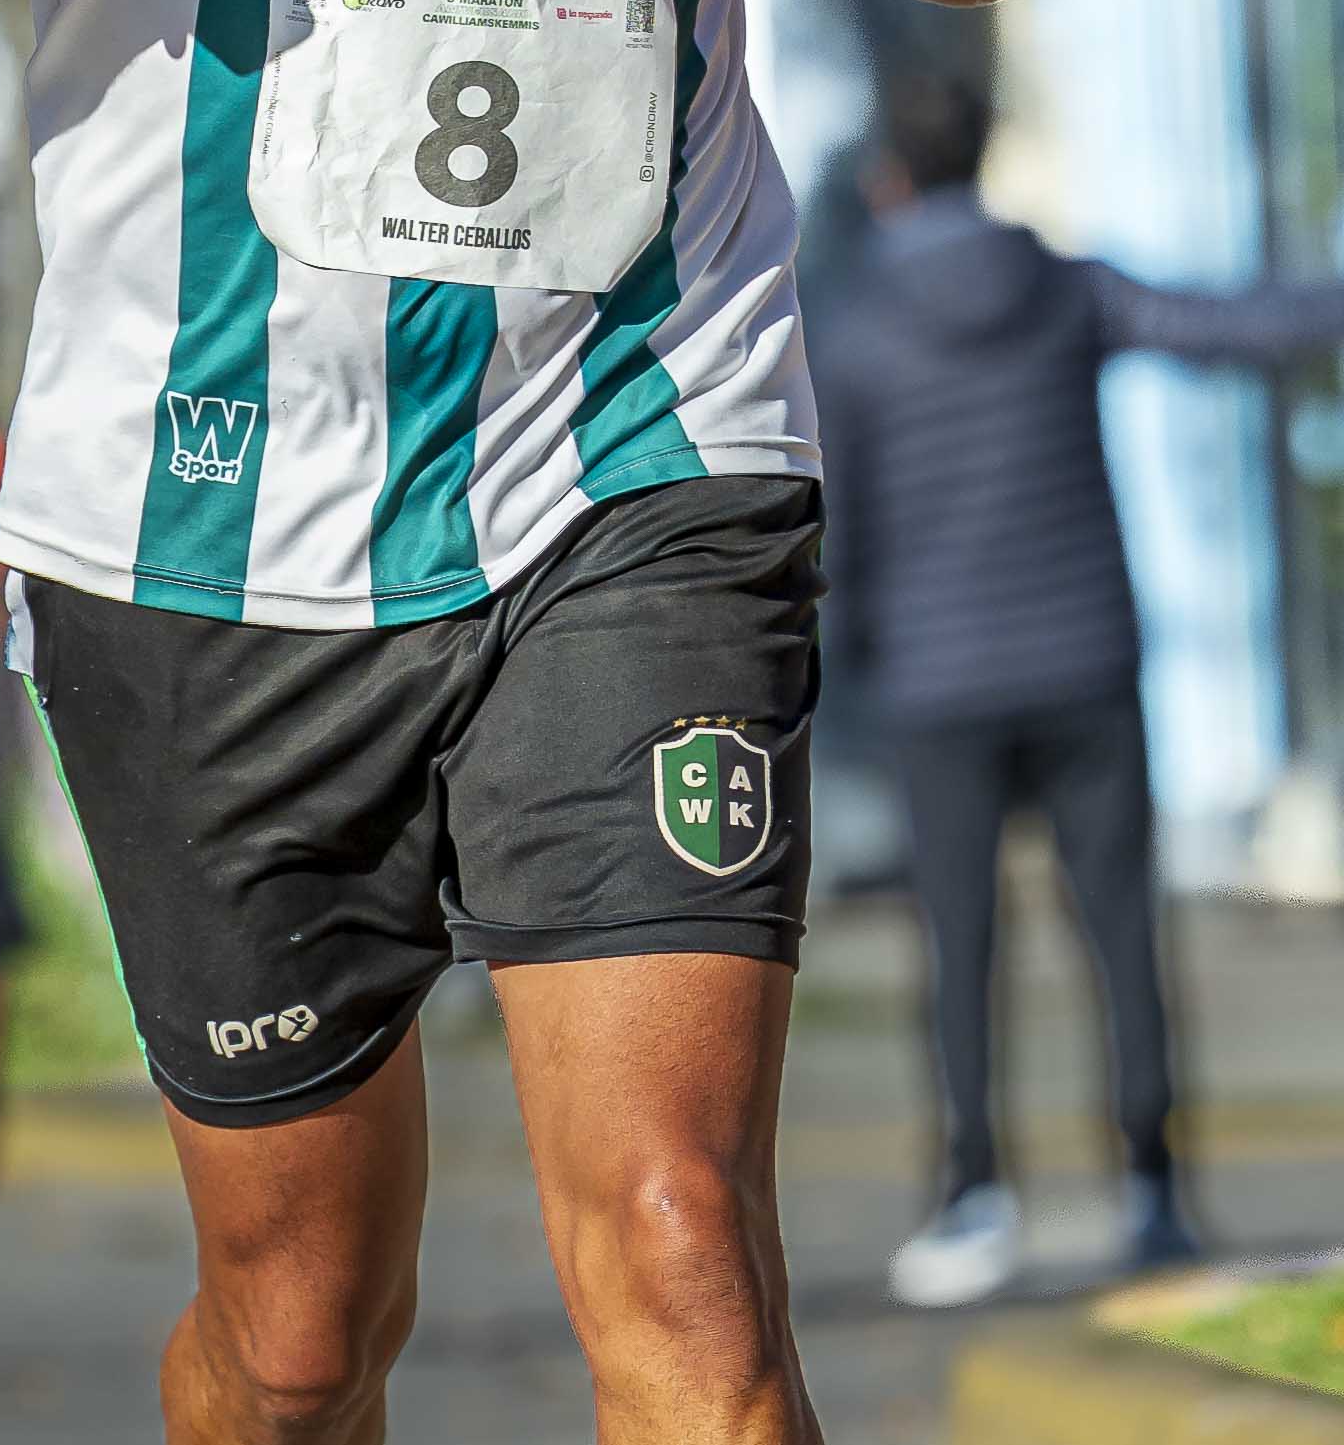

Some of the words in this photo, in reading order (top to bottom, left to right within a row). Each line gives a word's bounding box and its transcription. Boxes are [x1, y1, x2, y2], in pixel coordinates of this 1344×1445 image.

[414, 60, 520, 208] 8
[644, 92, 658, 163] @CRONORAV
[382, 216, 449, 245] WALTER
[453, 224, 532, 250] CEBALLOS
[174, 453, 239, 480] Sport
[681, 762, 708, 788] C
[728, 765, 754, 792] A
[678, 798, 713, 824] W
[728, 801, 755, 829] K
